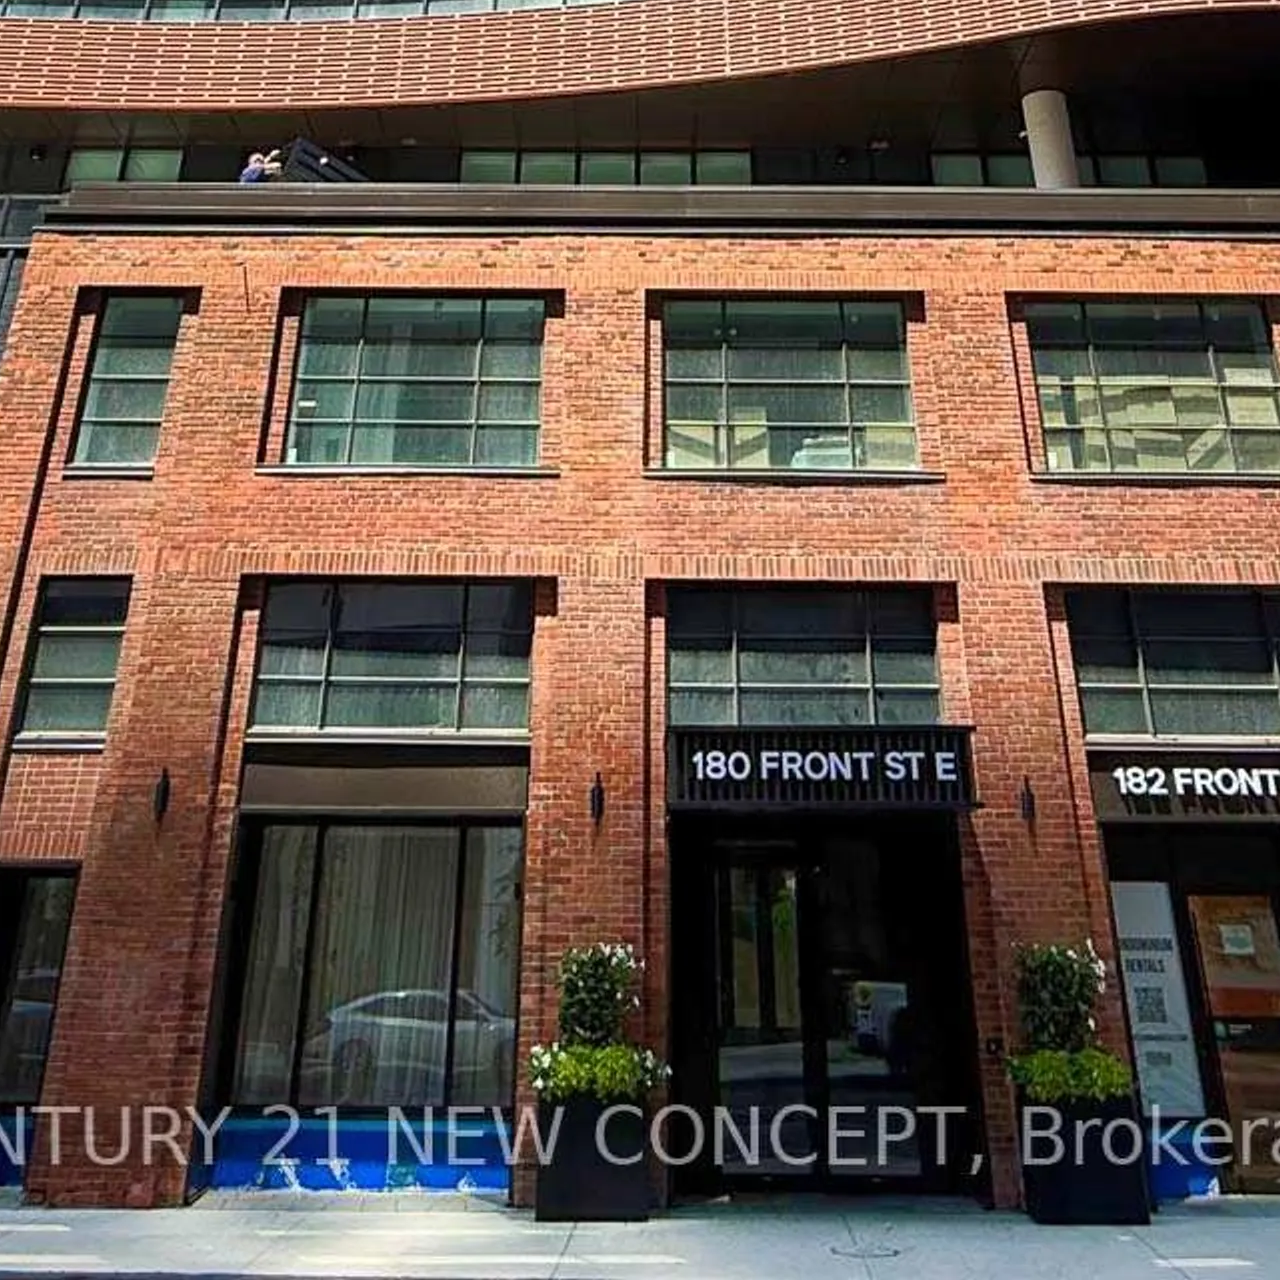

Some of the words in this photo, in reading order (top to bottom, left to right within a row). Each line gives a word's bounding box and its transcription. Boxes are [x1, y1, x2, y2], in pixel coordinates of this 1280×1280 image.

[692, 751, 751, 780] 180
[761, 751, 875, 780] FRONT
[884, 751, 925, 780] ST
[935, 752, 957, 780] E
[1113, 766, 1169, 795] 182
[1172, 768, 1280, 796] FRONT
